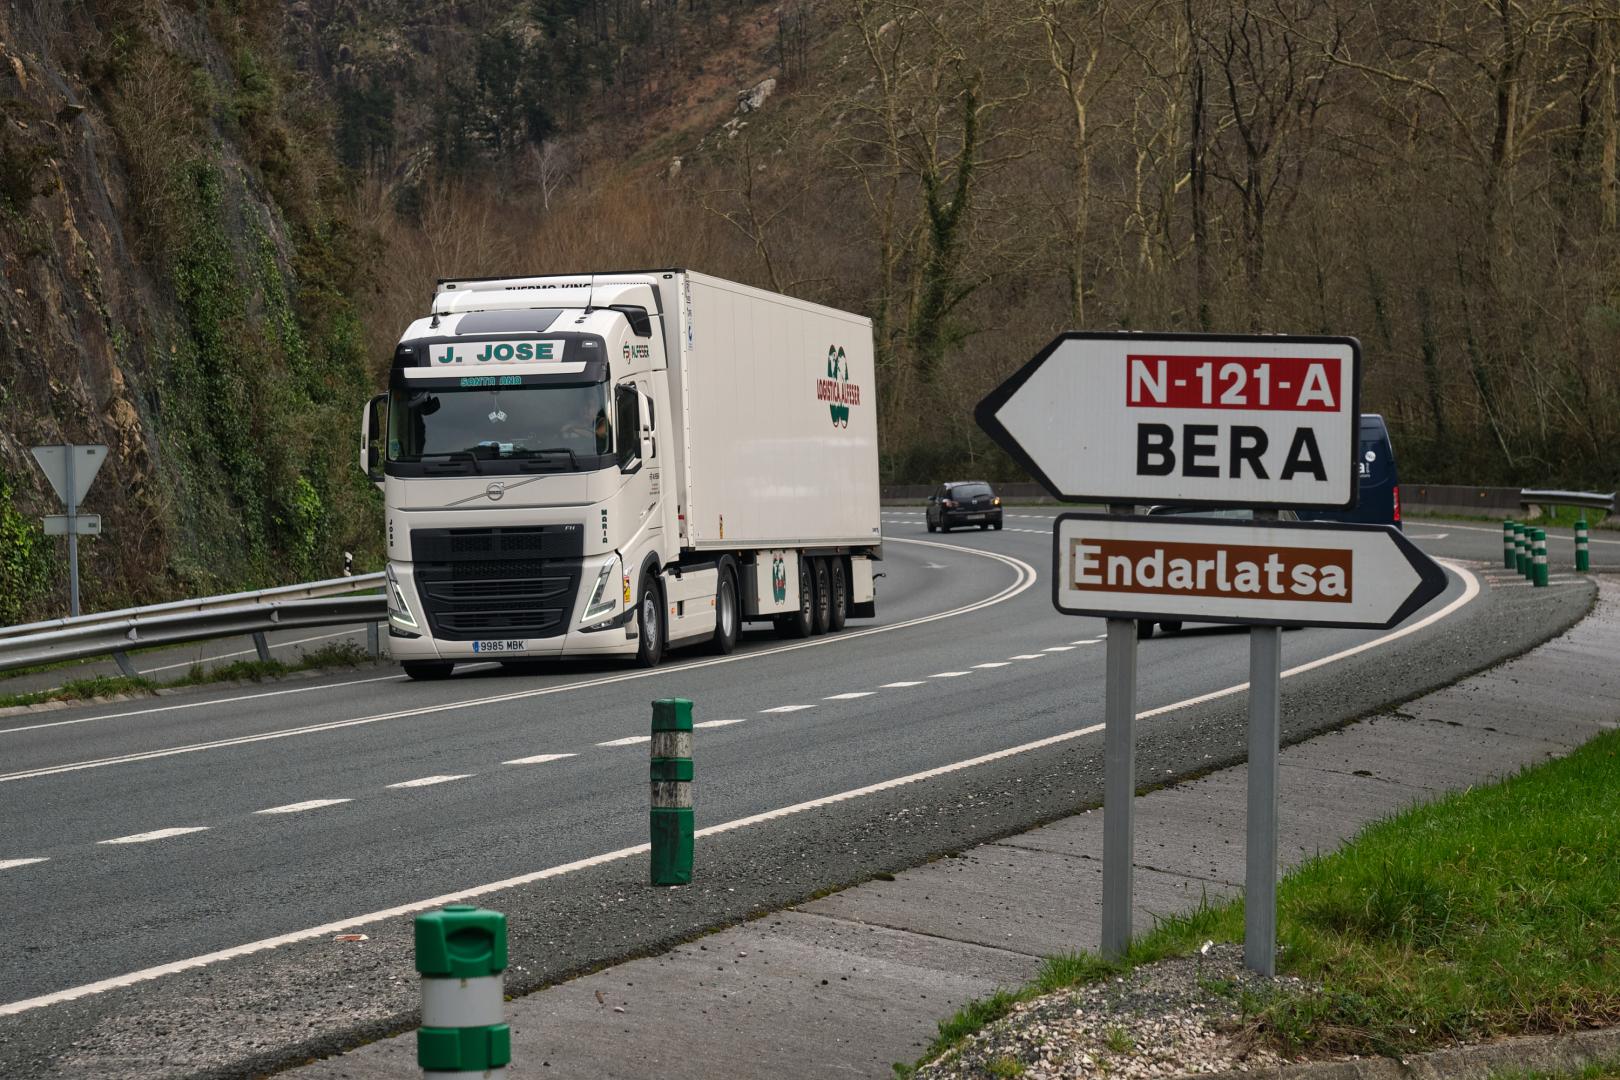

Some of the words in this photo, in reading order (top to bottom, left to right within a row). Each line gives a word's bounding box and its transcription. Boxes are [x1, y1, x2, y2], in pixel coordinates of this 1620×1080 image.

[438, 346, 463, 363] J.
[477, 343, 553, 362] JOSE
[460, 376, 496, 387] SANTA
[499, 375, 522, 386] ANA
[816, 377, 841, 403] LOGISTICA
[1131, 359, 1336, 407] N-121-A
[1136, 423, 1328, 481] BERA
[1075, 545, 1348, 597] Endarlatsa
[480, 641, 504, 651] 9985
[506, 640, 525, 650] MBK
